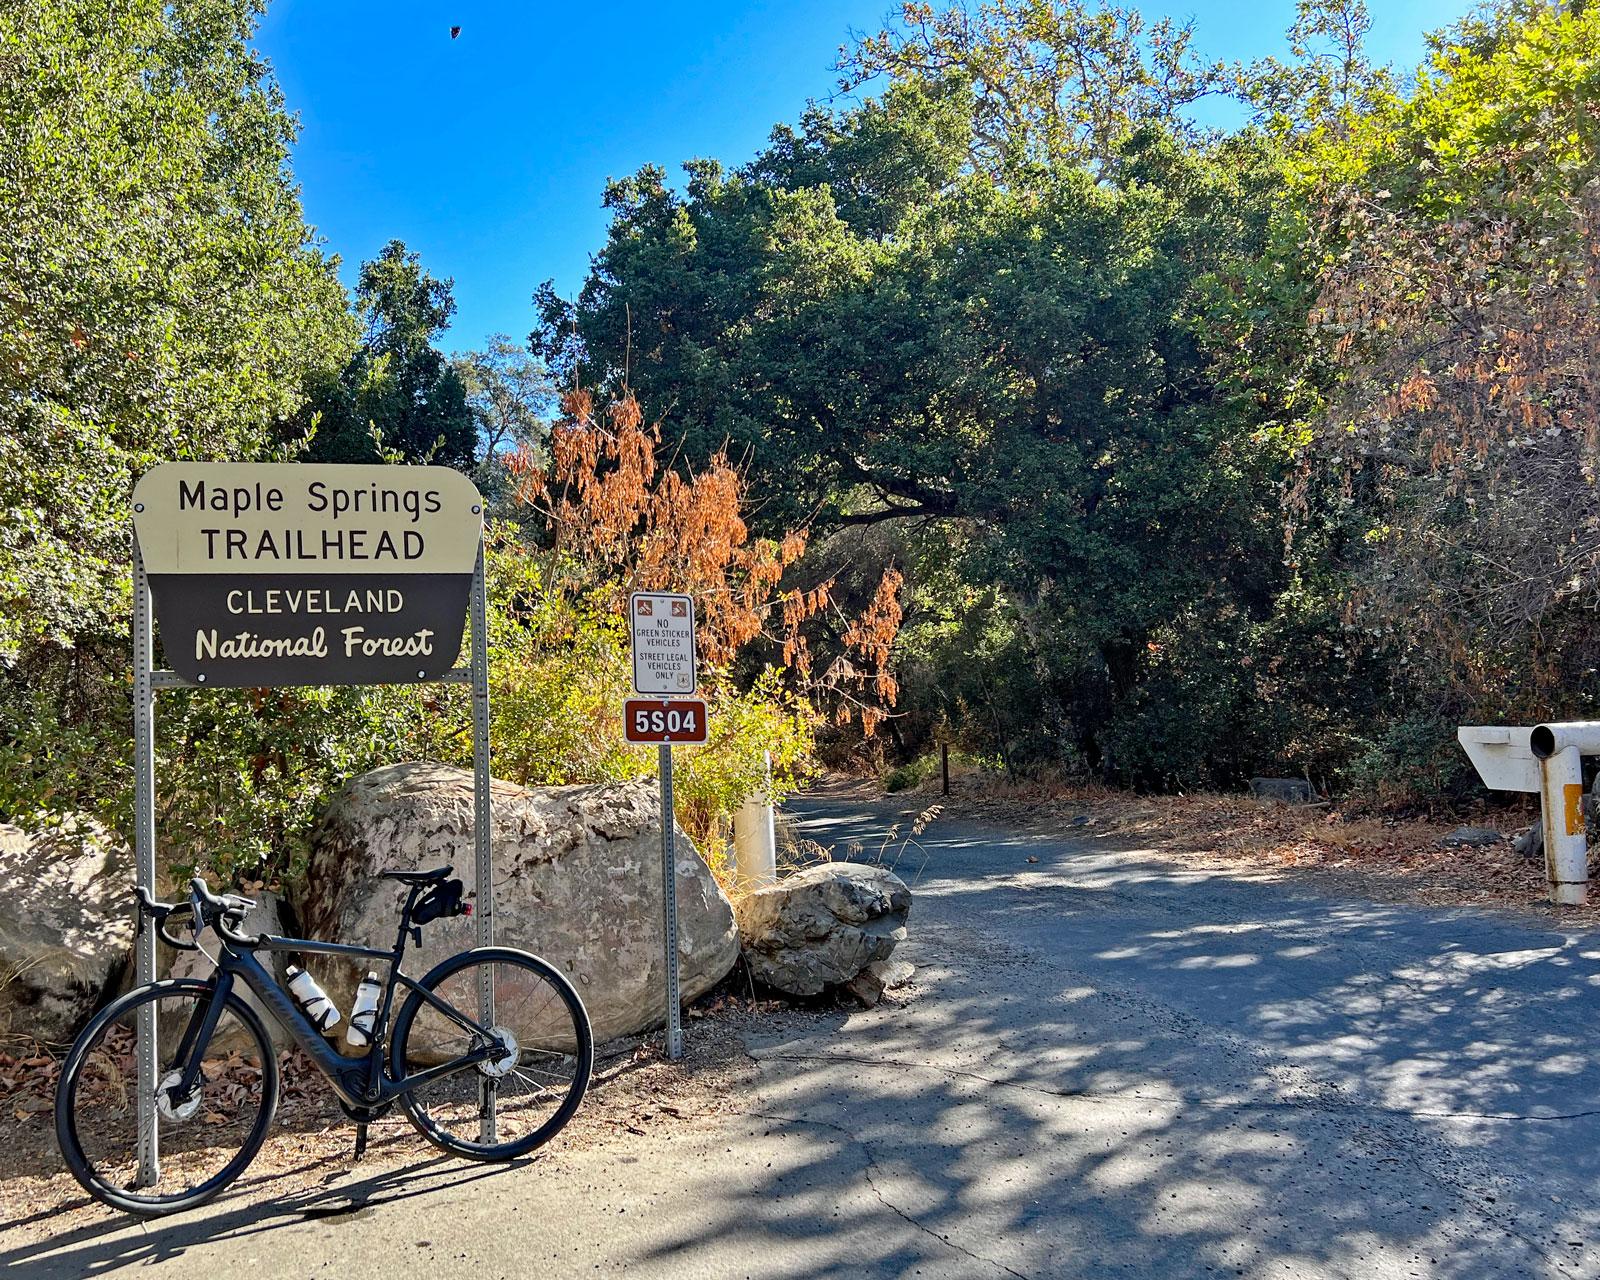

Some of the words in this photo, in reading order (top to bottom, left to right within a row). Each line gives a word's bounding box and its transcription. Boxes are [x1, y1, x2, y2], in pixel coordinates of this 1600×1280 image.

[179, 480, 284, 519] Maple
[307, 481, 442, 522] Springs
[201, 529, 425, 560] TRAILHEAD
[226, 589, 403, 614] CLEVELAND
[657, 619, 669, 628] NO
[636, 629, 660, 637] GREEN
[661, 630, 690, 638] STICKER
[195, 626, 328, 660] National
[340, 626, 434, 658] Forest
[646, 638, 680, 647] VEHICLES
[639, 652, 665, 661] STREET
[666, 653, 688, 662] LEGAL
[647, 662, 681, 670] VEHICLES
[655, 671, 674, 680] ONLY
[635, 710, 696, 733] 5S04
